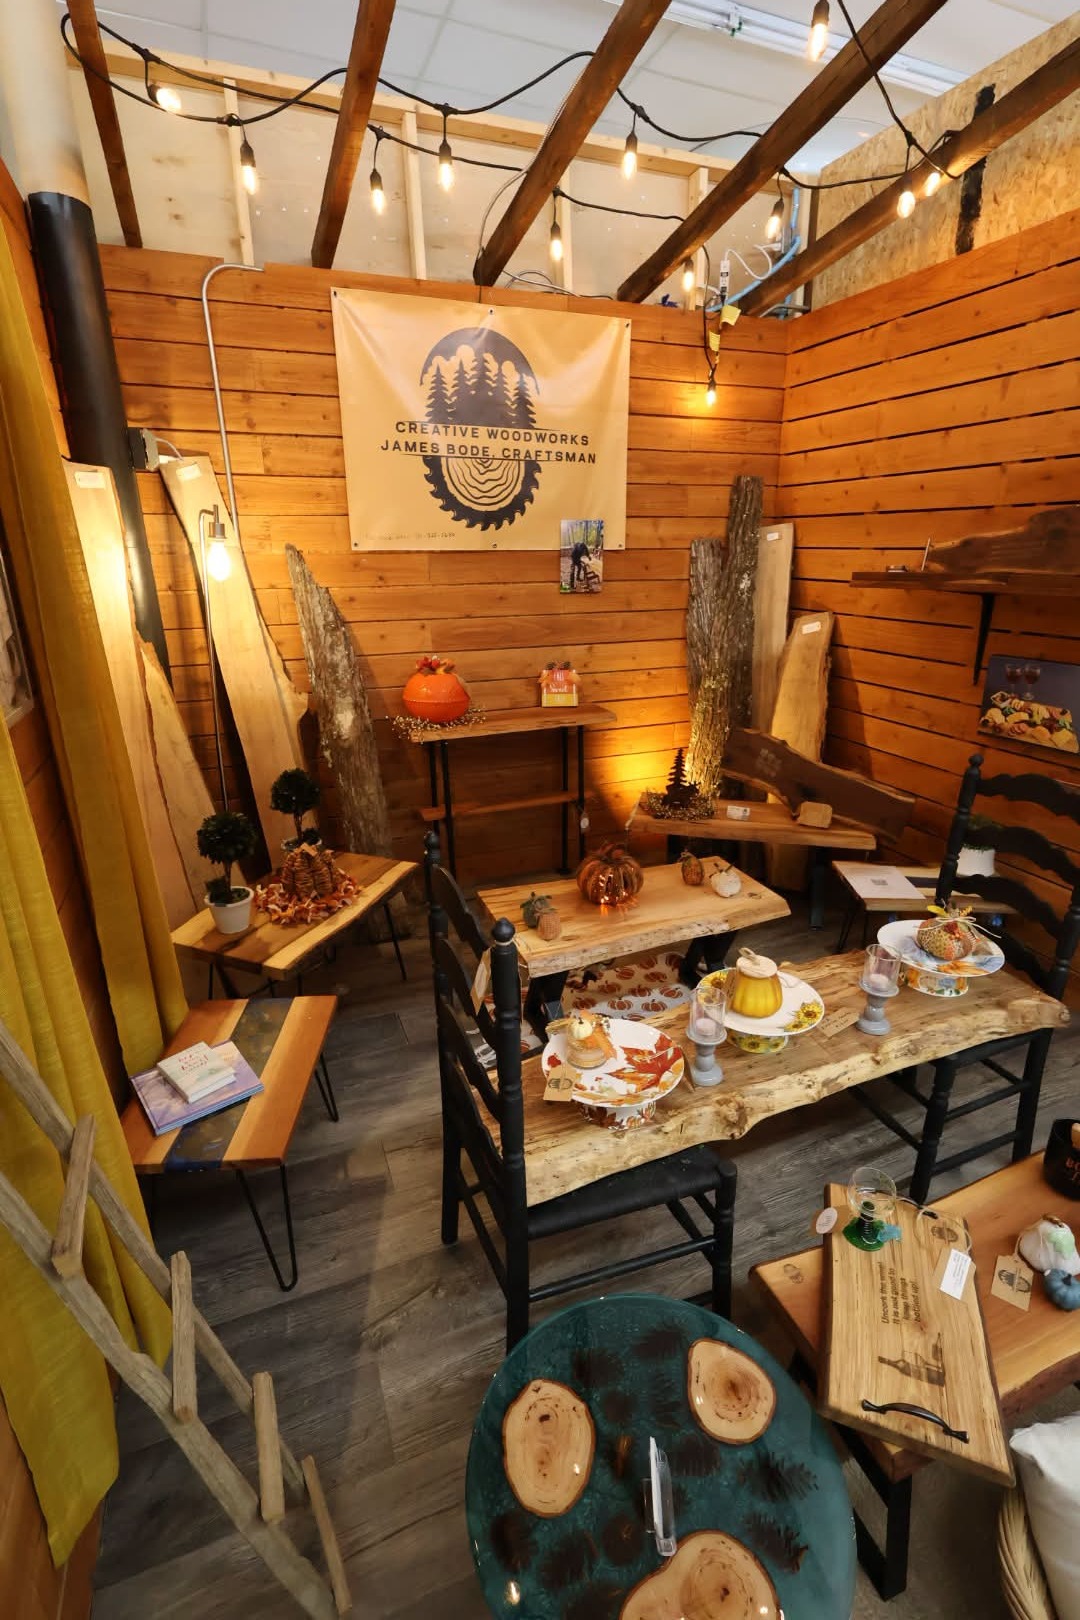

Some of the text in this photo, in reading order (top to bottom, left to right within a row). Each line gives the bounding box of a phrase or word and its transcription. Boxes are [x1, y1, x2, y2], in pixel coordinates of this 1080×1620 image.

[395, 421, 590, 446] CREATIVE WOODWORKS
[380, 439, 440, 454] JAMES
[501, 447, 597, 464] CRAFTSMAN
[881, 1296, 889, 1324] Uncork
